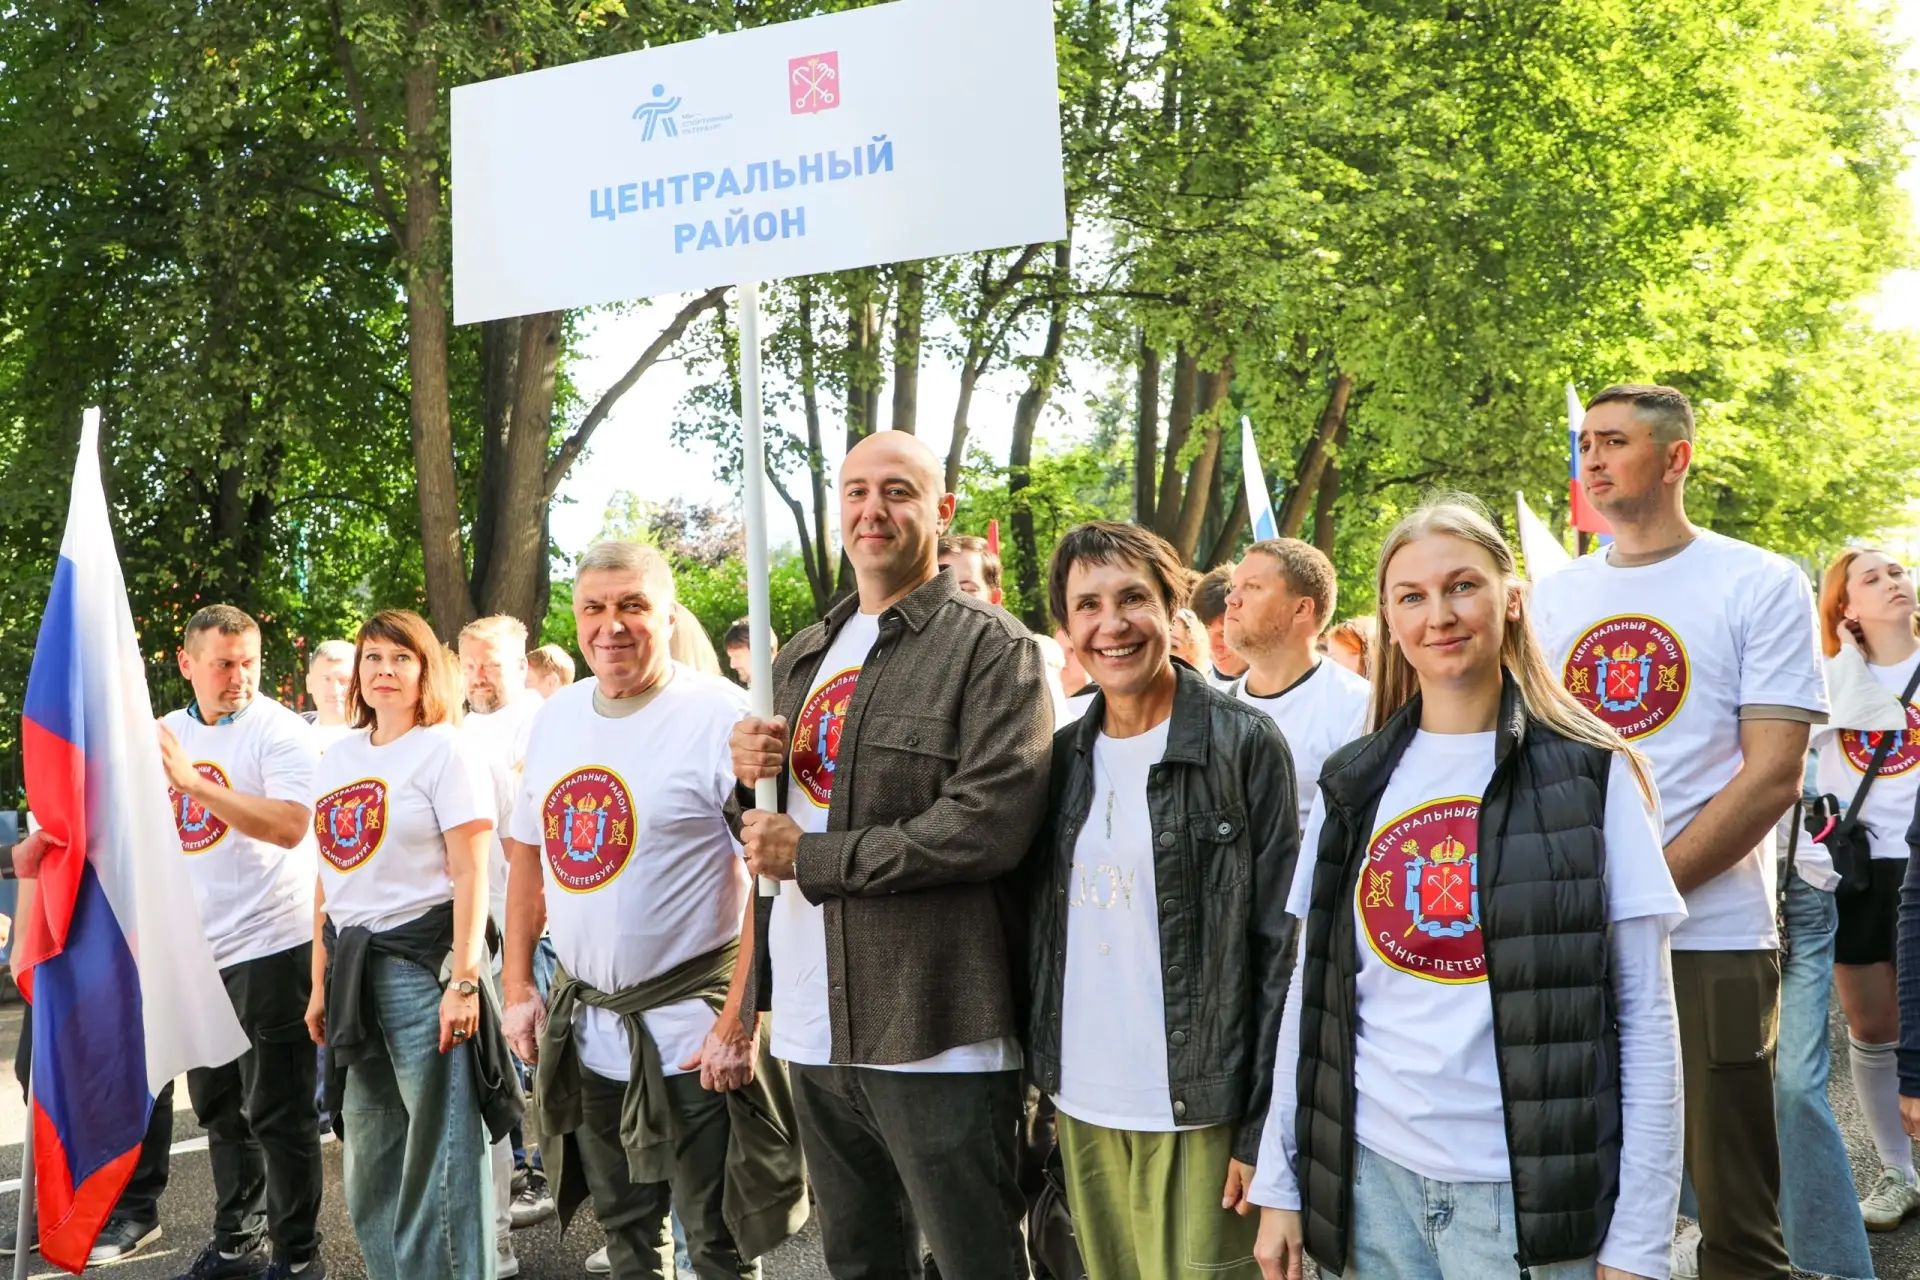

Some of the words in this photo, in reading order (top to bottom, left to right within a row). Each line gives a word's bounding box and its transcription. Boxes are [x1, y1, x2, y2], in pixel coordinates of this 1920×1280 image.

[590, 134, 894, 221] ЦЕНТРАЛЬНЫЙ
[674, 206, 806, 254] РАЙОН
[1572, 621, 1647, 662] ЦЕНТРАЛЬНЫЙ
[1649, 627, 1679, 660] РАЙОН
[804, 673, 859, 719] ЦЕНТРАЛЬН
[1614, 707, 1665, 734] ЕТЕРБУРГ
[318, 782, 375, 808] ЦЕНТРАЛЬНЫЙ
[547, 772, 608, 809] ЦЕНТРАЛЬНЫЙ
[608, 779, 628, 814] РАЙОН
[801, 768, 832, 799] САНКТ-ПЕ
[1371, 806, 1479, 862] ЦЕНТРАЛЬНЫЙ
[550, 854, 616, 885] САНКТ-ПЕТЕРБУРГ
[1379, 931, 1486, 971] САНКТ-ПЕТЕР
